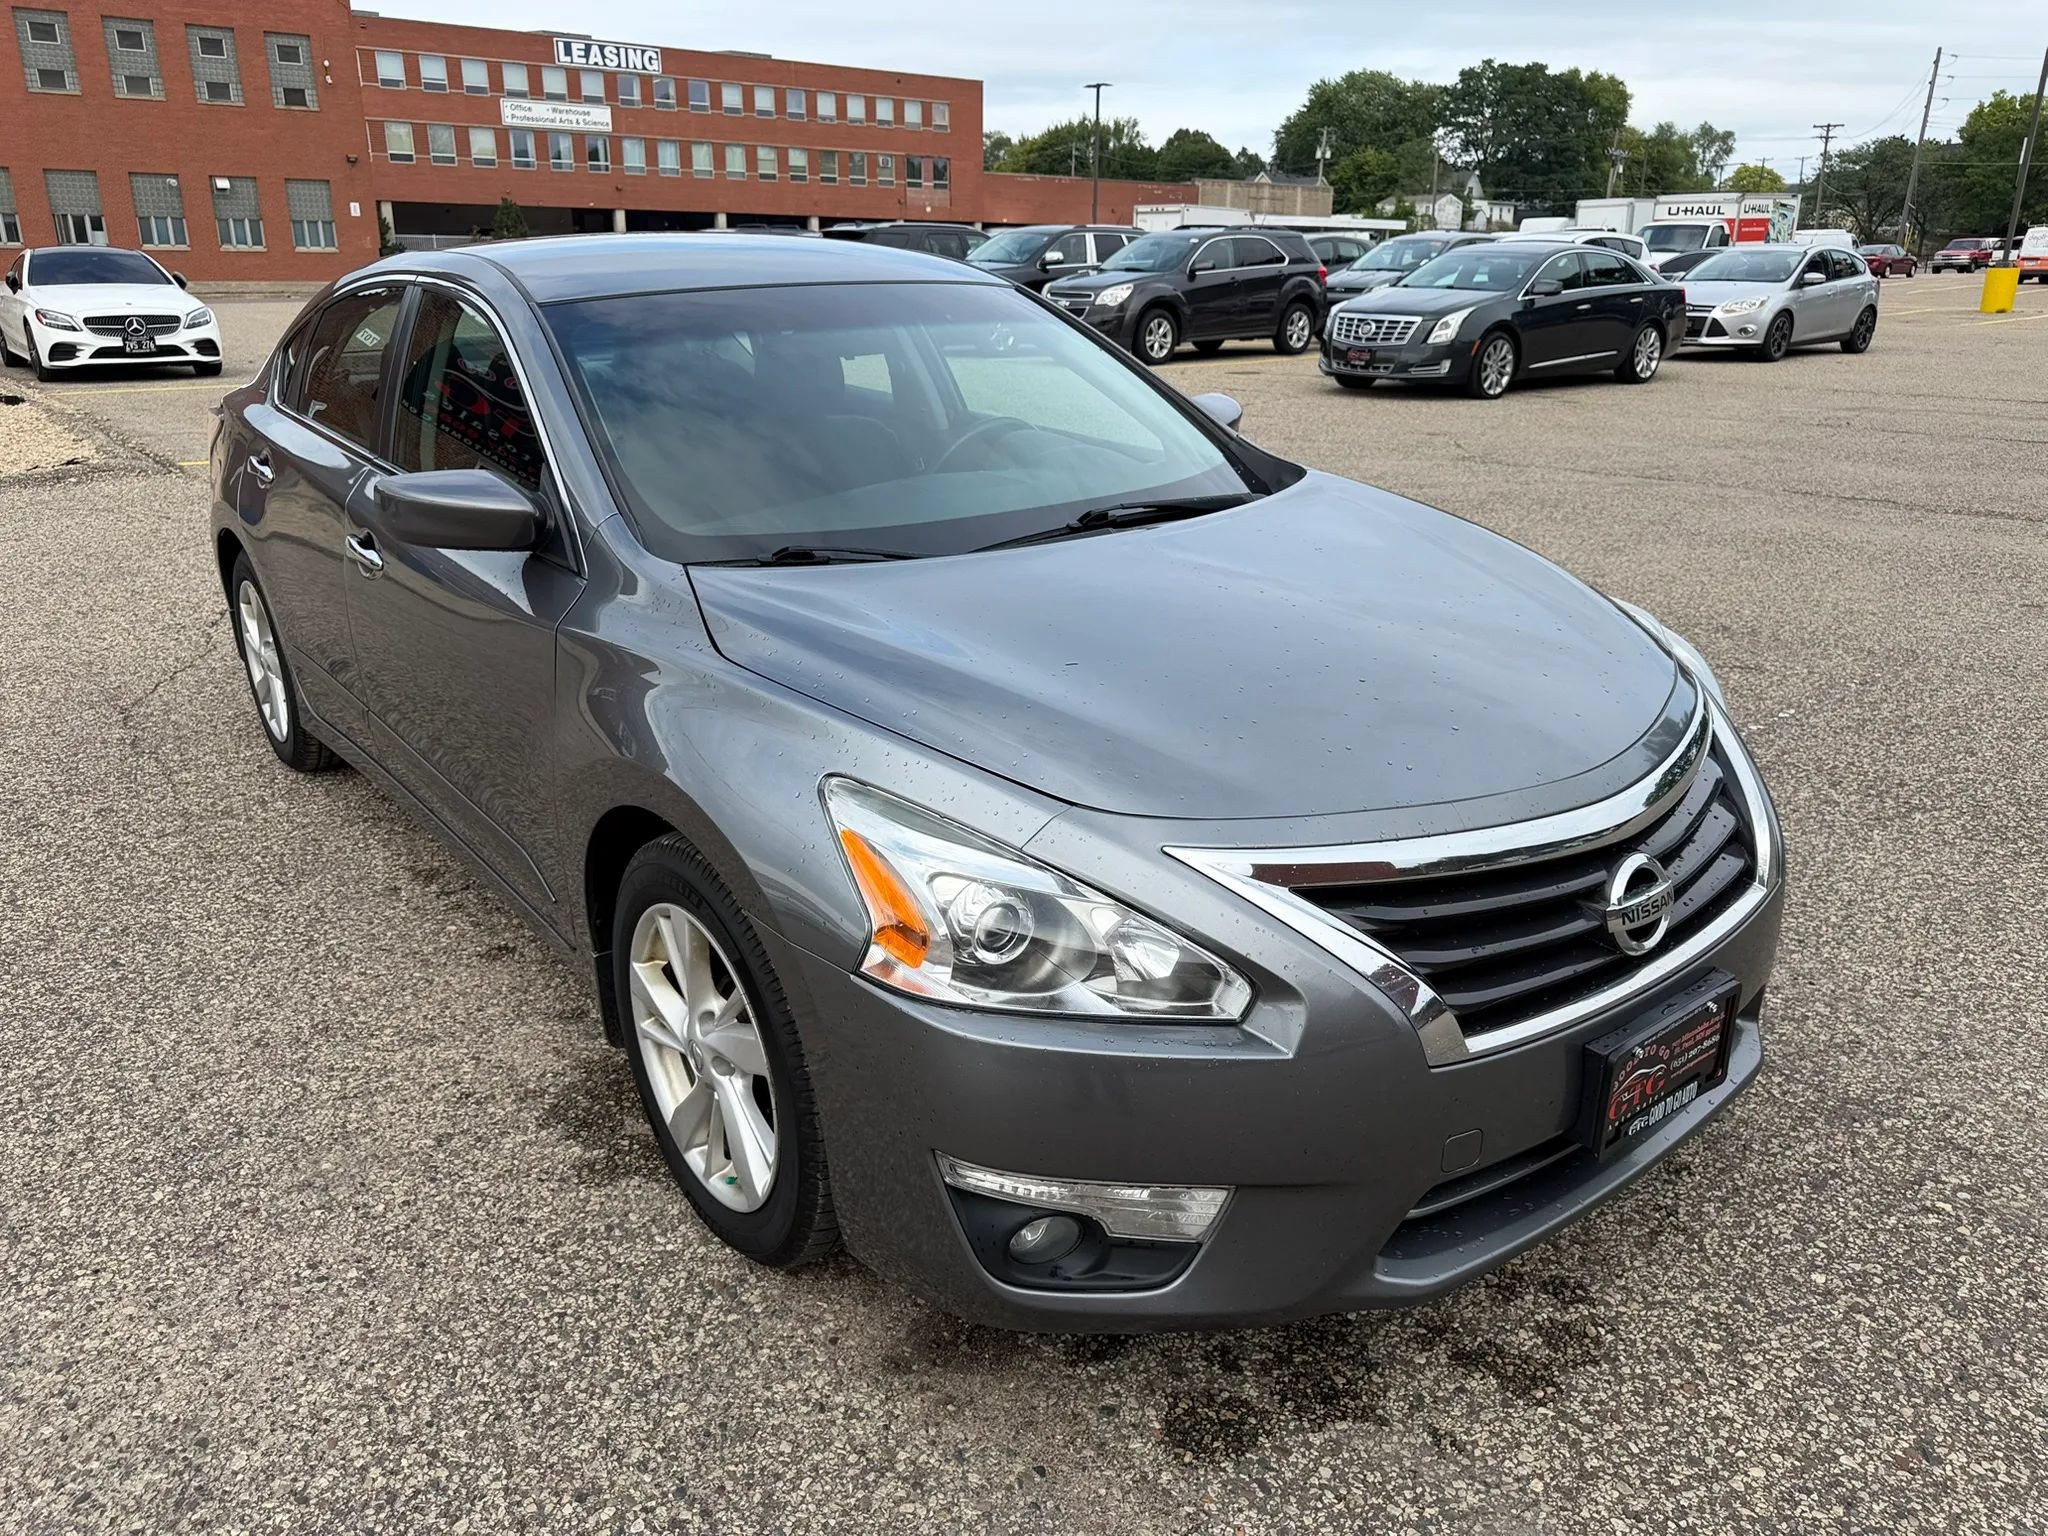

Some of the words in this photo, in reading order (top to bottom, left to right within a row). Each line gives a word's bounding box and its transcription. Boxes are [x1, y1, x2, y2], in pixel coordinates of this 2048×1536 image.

[557, 41, 659, 71] LEASING
[510, 103, 532, 113] Office
[551, 107, 591, 117] Warehouse
[511, 113, 557, 124] Professional
[559, 117, 573, 125] Arts
[575, 118, 581, 126] &
[582, 119, 609, 127] Science
[1668, 205, 1725, 216] U-HAUL
[1744, 203, 1770, 214] U-HAUL
[1621, 890, 1674, 926] NISSAN
